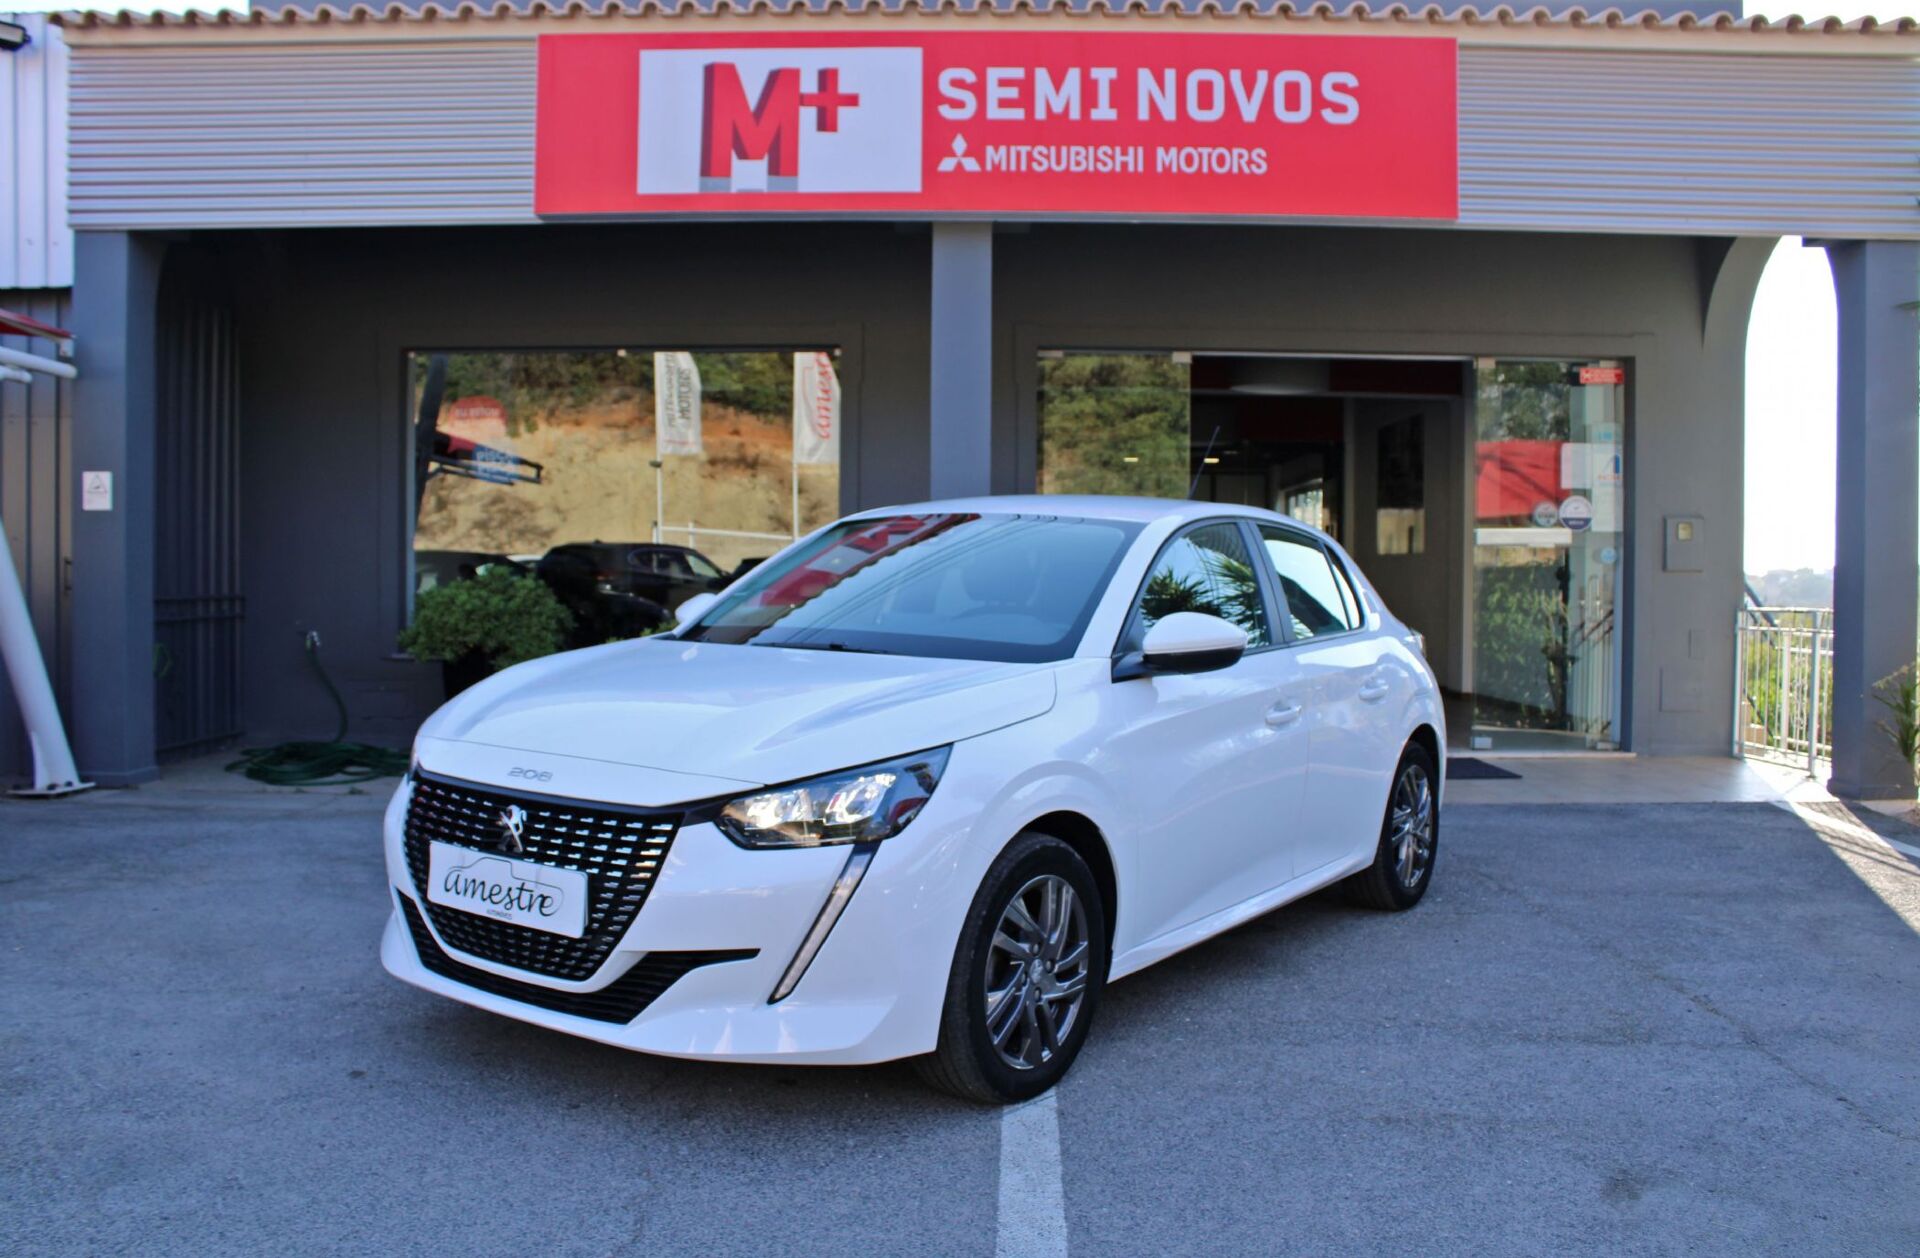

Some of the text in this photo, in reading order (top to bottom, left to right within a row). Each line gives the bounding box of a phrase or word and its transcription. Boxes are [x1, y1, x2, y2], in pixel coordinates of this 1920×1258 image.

[936, 67, 1361, 126] SEMI NOVOS
[985, 143, 1269, 176] MITSUBISHI MOTORS
[508, 767, 553, 782] 208
[443, 873, 555, 917] amestre
